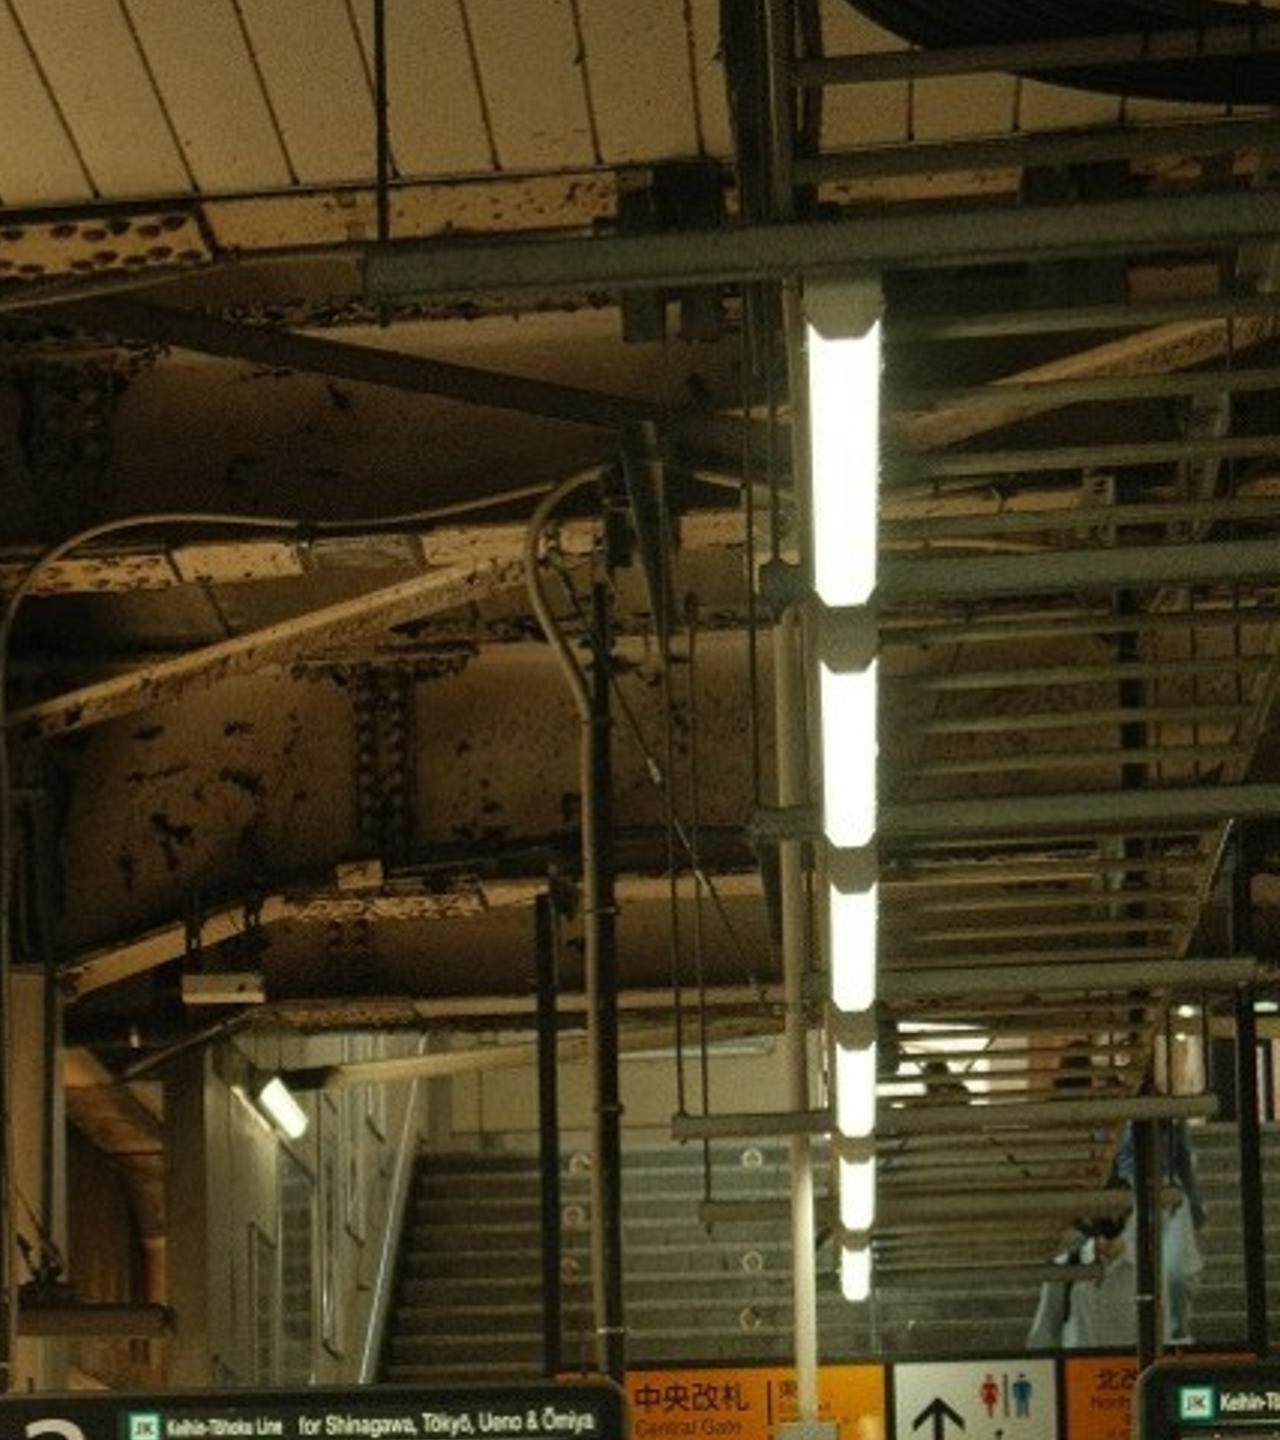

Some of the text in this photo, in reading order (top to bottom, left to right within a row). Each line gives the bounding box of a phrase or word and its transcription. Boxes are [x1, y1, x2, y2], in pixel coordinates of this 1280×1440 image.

[635, 1382, 750, 1411] 中央改札
[256, 1414, 283, 1436] Line
[298, 1415, 321, 1436] for
[325, 1413, 418, 1439] Shinagawa,
[478, 1412, 523, 1432] Ueno
[526, 1410, 539, 1430] &
[702, 1418, 743, 1436] Gate
